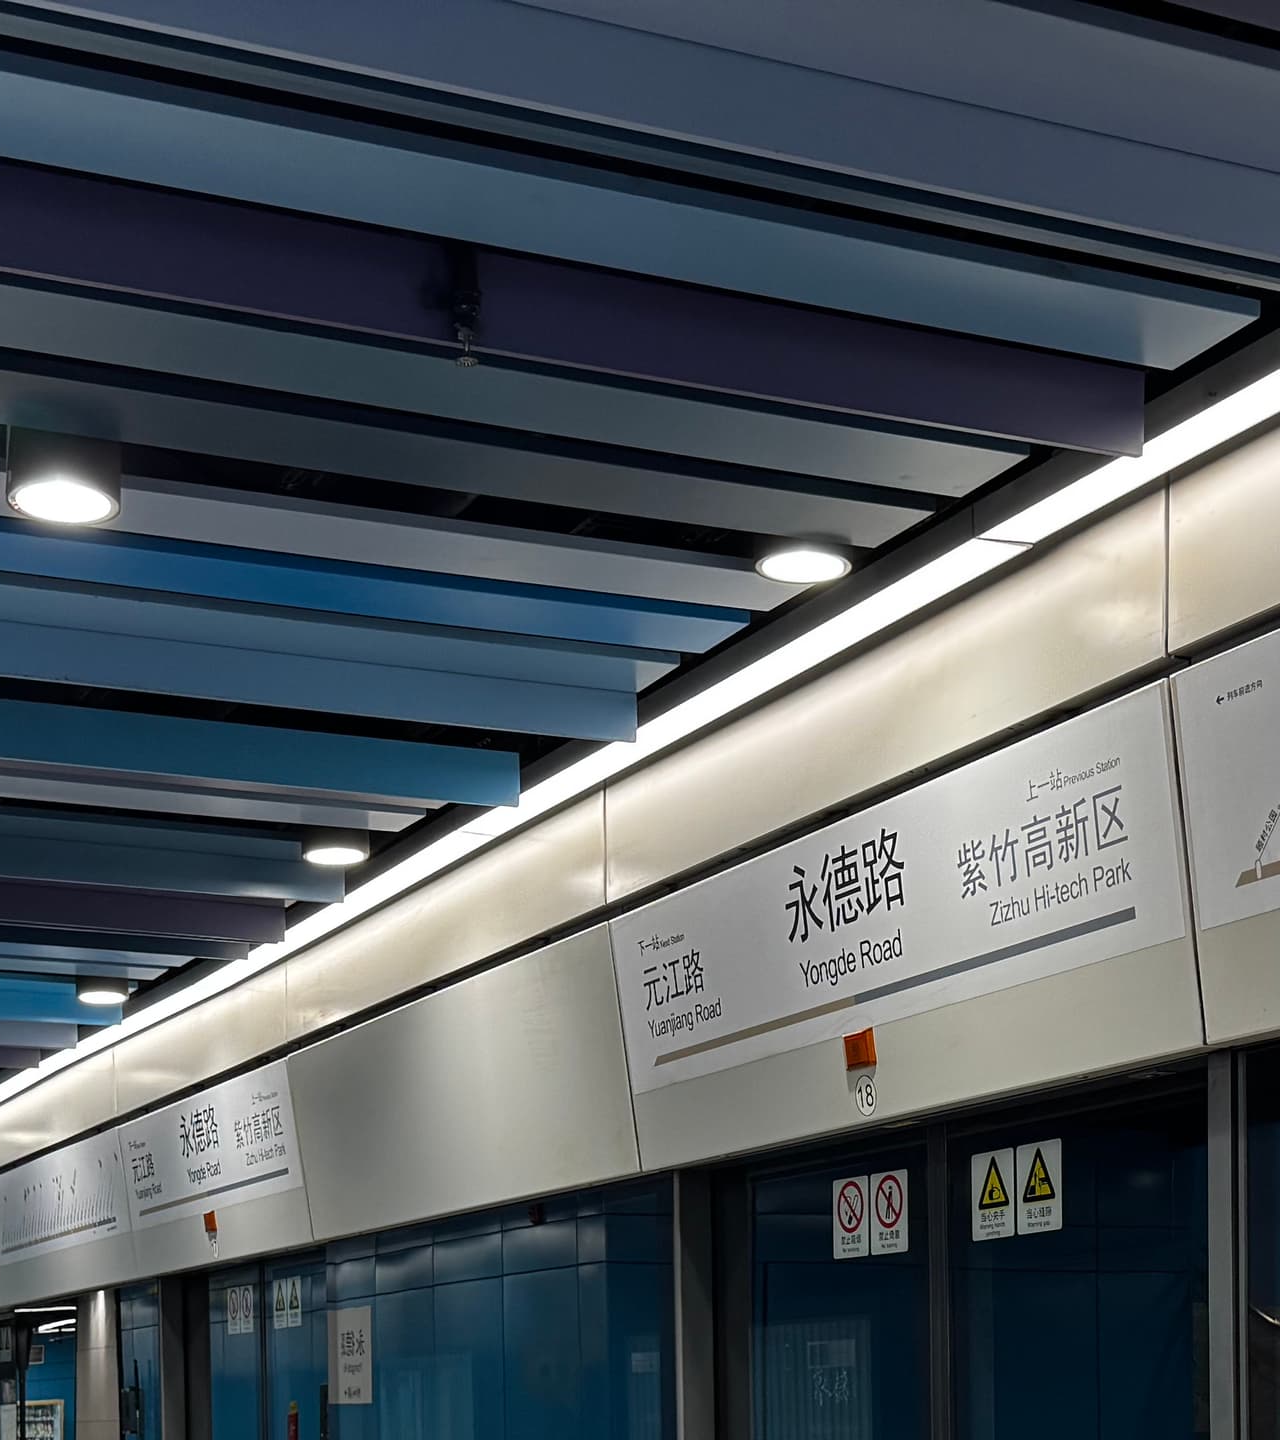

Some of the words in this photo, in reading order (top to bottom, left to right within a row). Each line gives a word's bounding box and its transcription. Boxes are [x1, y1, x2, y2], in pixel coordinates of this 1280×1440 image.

[1025, 769, 1063, 802] 上一站
[956, 785, 1129, 900] 紫竹高新区
[785, 828, 905, 944] 永德路
[990, 895, 1031, 927] Zizhu
[1033, 875, 1089, 912] Hi-tech
[1094, 857, 1133, 898] Park
[637, 935, 660, 957] 下一站
[800, 946, 856, 989] Yongde
[859, 929, 903, 970] Road
[642, 949, 704, 1012] 元江路
[647, 1003, 695, 1039] Yuanjiang
[695, 997, 722, 1028] Road
[856, 1086, 875, 1109] 18
[180, 1104, 220, 1158] 永德路
[234, 1105, 284, 1149] 紫竹高新区
